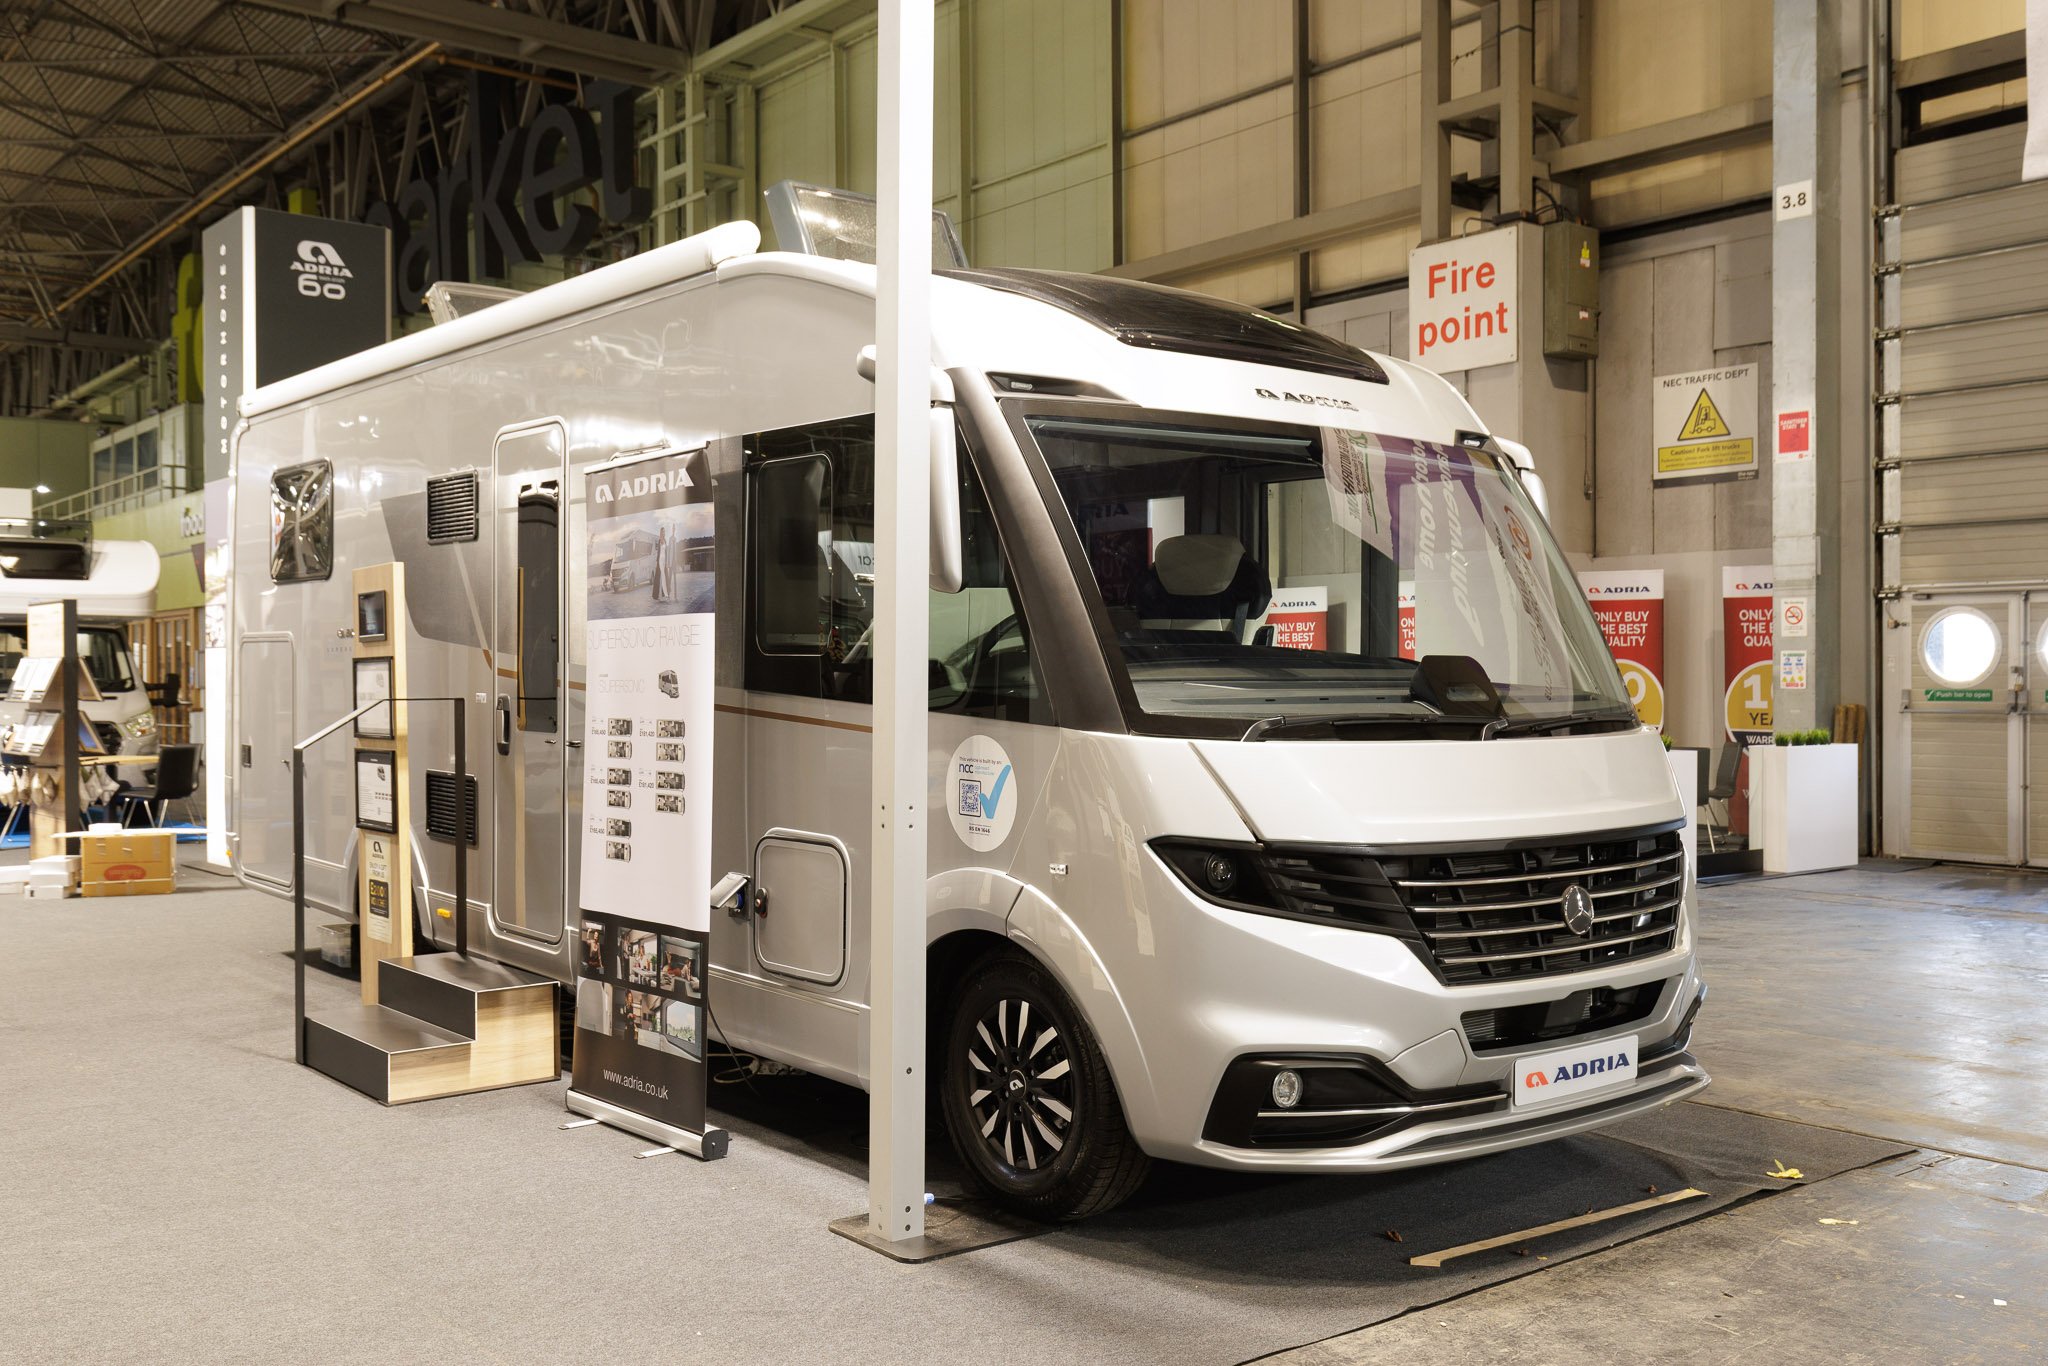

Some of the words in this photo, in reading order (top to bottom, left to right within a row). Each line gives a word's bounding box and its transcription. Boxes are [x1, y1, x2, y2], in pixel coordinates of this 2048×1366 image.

[1782, 192, 1806, 209] 3.8
[290, 261, 354, 278] ADRIA
[298, 273, 346, 300] 60
[1428, 259, 1496, 299] Fire
[1418, 302, 1509, 357] point
[1663, 378, 1682, 389] NEC
[1685, 372, 1722, 386] TRAFFIC
[1725, 367, 1750, 380] DEPT
[618, 467, 695, 501] ADRIA
[1604, 586, 1651, 594] ADRIA
[1280, 600, 1317, 608] ADRIA
[1625, 610, 1650, 622] BUY
[1296, 621, 1317, 632] BUY
[1600, 623, 1616, 635] HE
[1618, 623, 1649, 635] BEST
[1740, 621, 1767, 634] THE
[588, 626, 656, 651] SUPERSONIC
[659, 624, 701, 648] RANGE
[1278, 634, 1292, 643] HE
[1292, 632, 1315, 643] BEST
[1608, 635, 1646, 647] UALITY
[599, 679, 646, 695] SUPERSONIC
[1973, 692, 1991, 700] open
[958, 763, 974, 774] ncc
[1553, 1052, 1630, 1084] ADRIA
[603, 1068, 669, 1100] www.adria.co.uk
